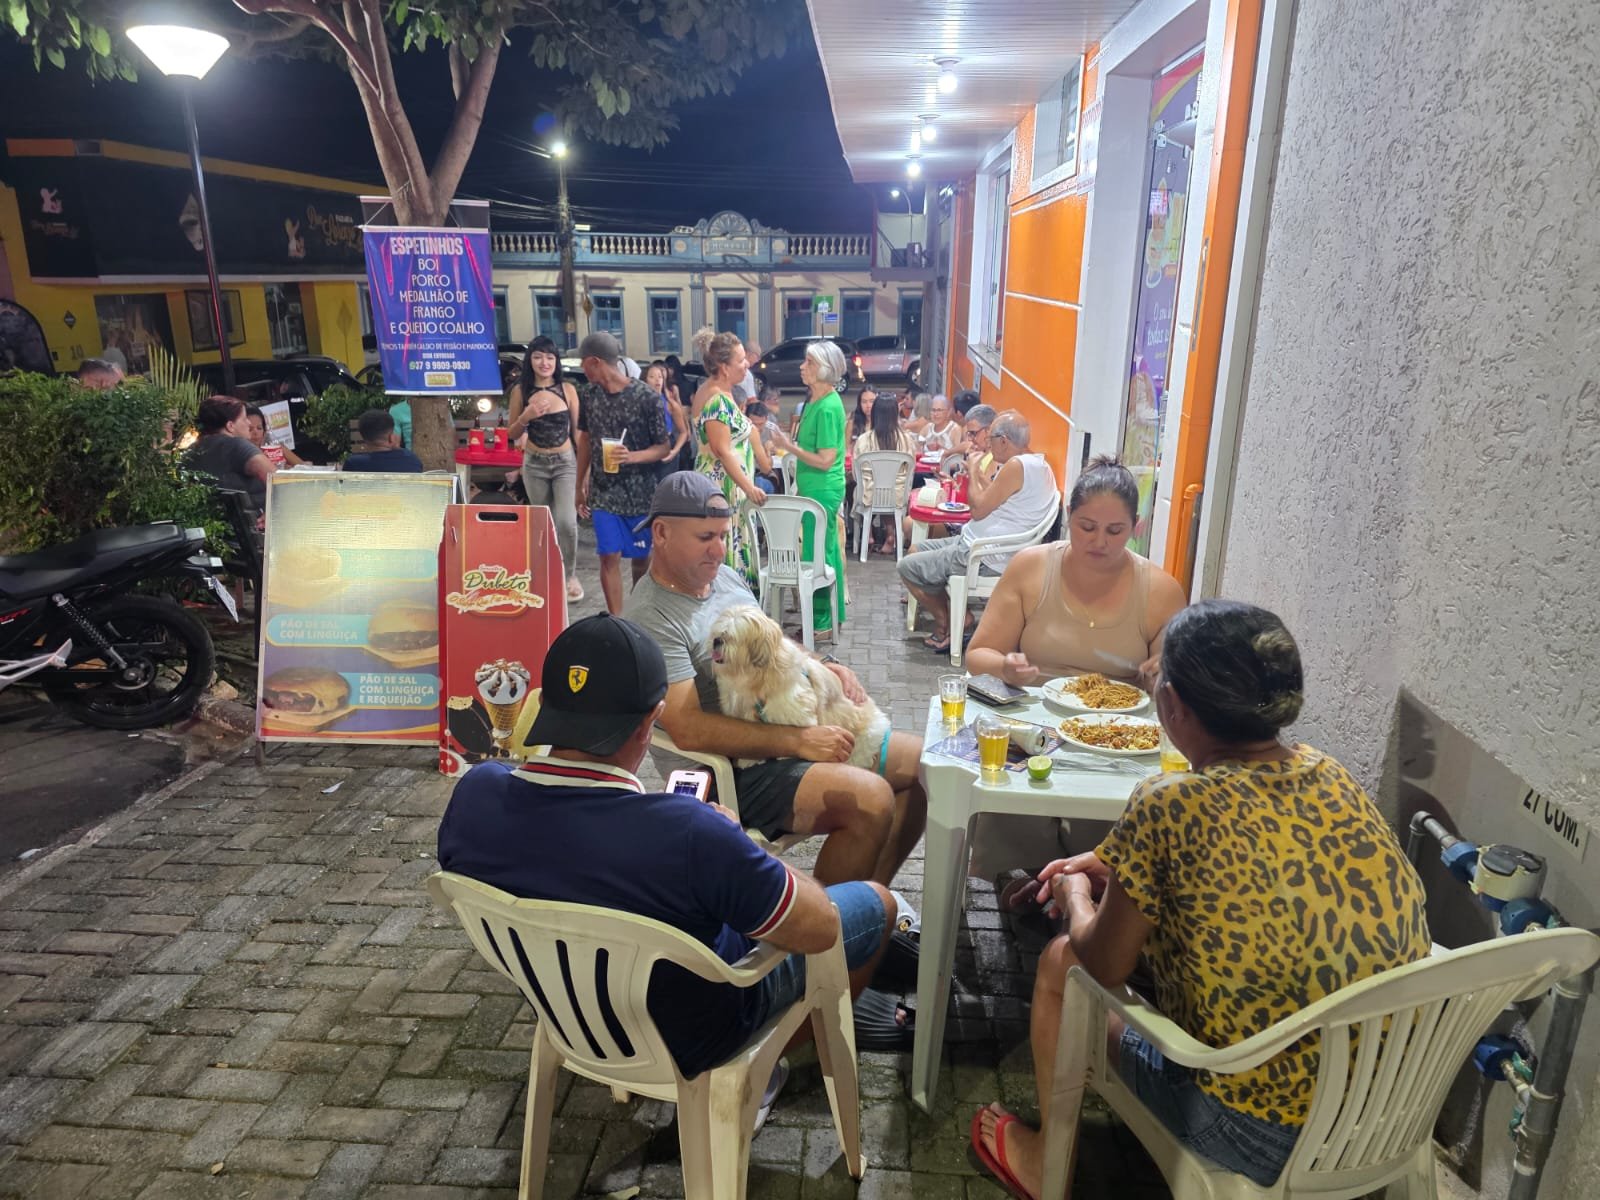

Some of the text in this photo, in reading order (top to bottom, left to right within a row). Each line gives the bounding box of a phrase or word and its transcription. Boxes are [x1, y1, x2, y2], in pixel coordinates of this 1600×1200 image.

[390, 237, 463, 255] ESPETINHOS
[418, 258, 439, 271] BOI
[411, 274, 451, 287] PORCO
[400, 288, 469, 303] MEDALHÃO DE
[413, 306, 456, 318] FRANGO
[389, 321, 485, 336] E QUEIJO COALHO
[435, 342, 442, 350] DE
[425, 361, 431, 370] 9
[280, 619, 339, 629] PÃO DE SAL
[280, 630, 358, 641] COM LINGUIÇA
[359, 673, 417, 685] PÃO DE SAL
[359, 685, 434, 696] COM LINGUIÇA
[359, 694, 422, 705] E REQUEIJÃO
[1545, 800, 1579, 847] COM.
